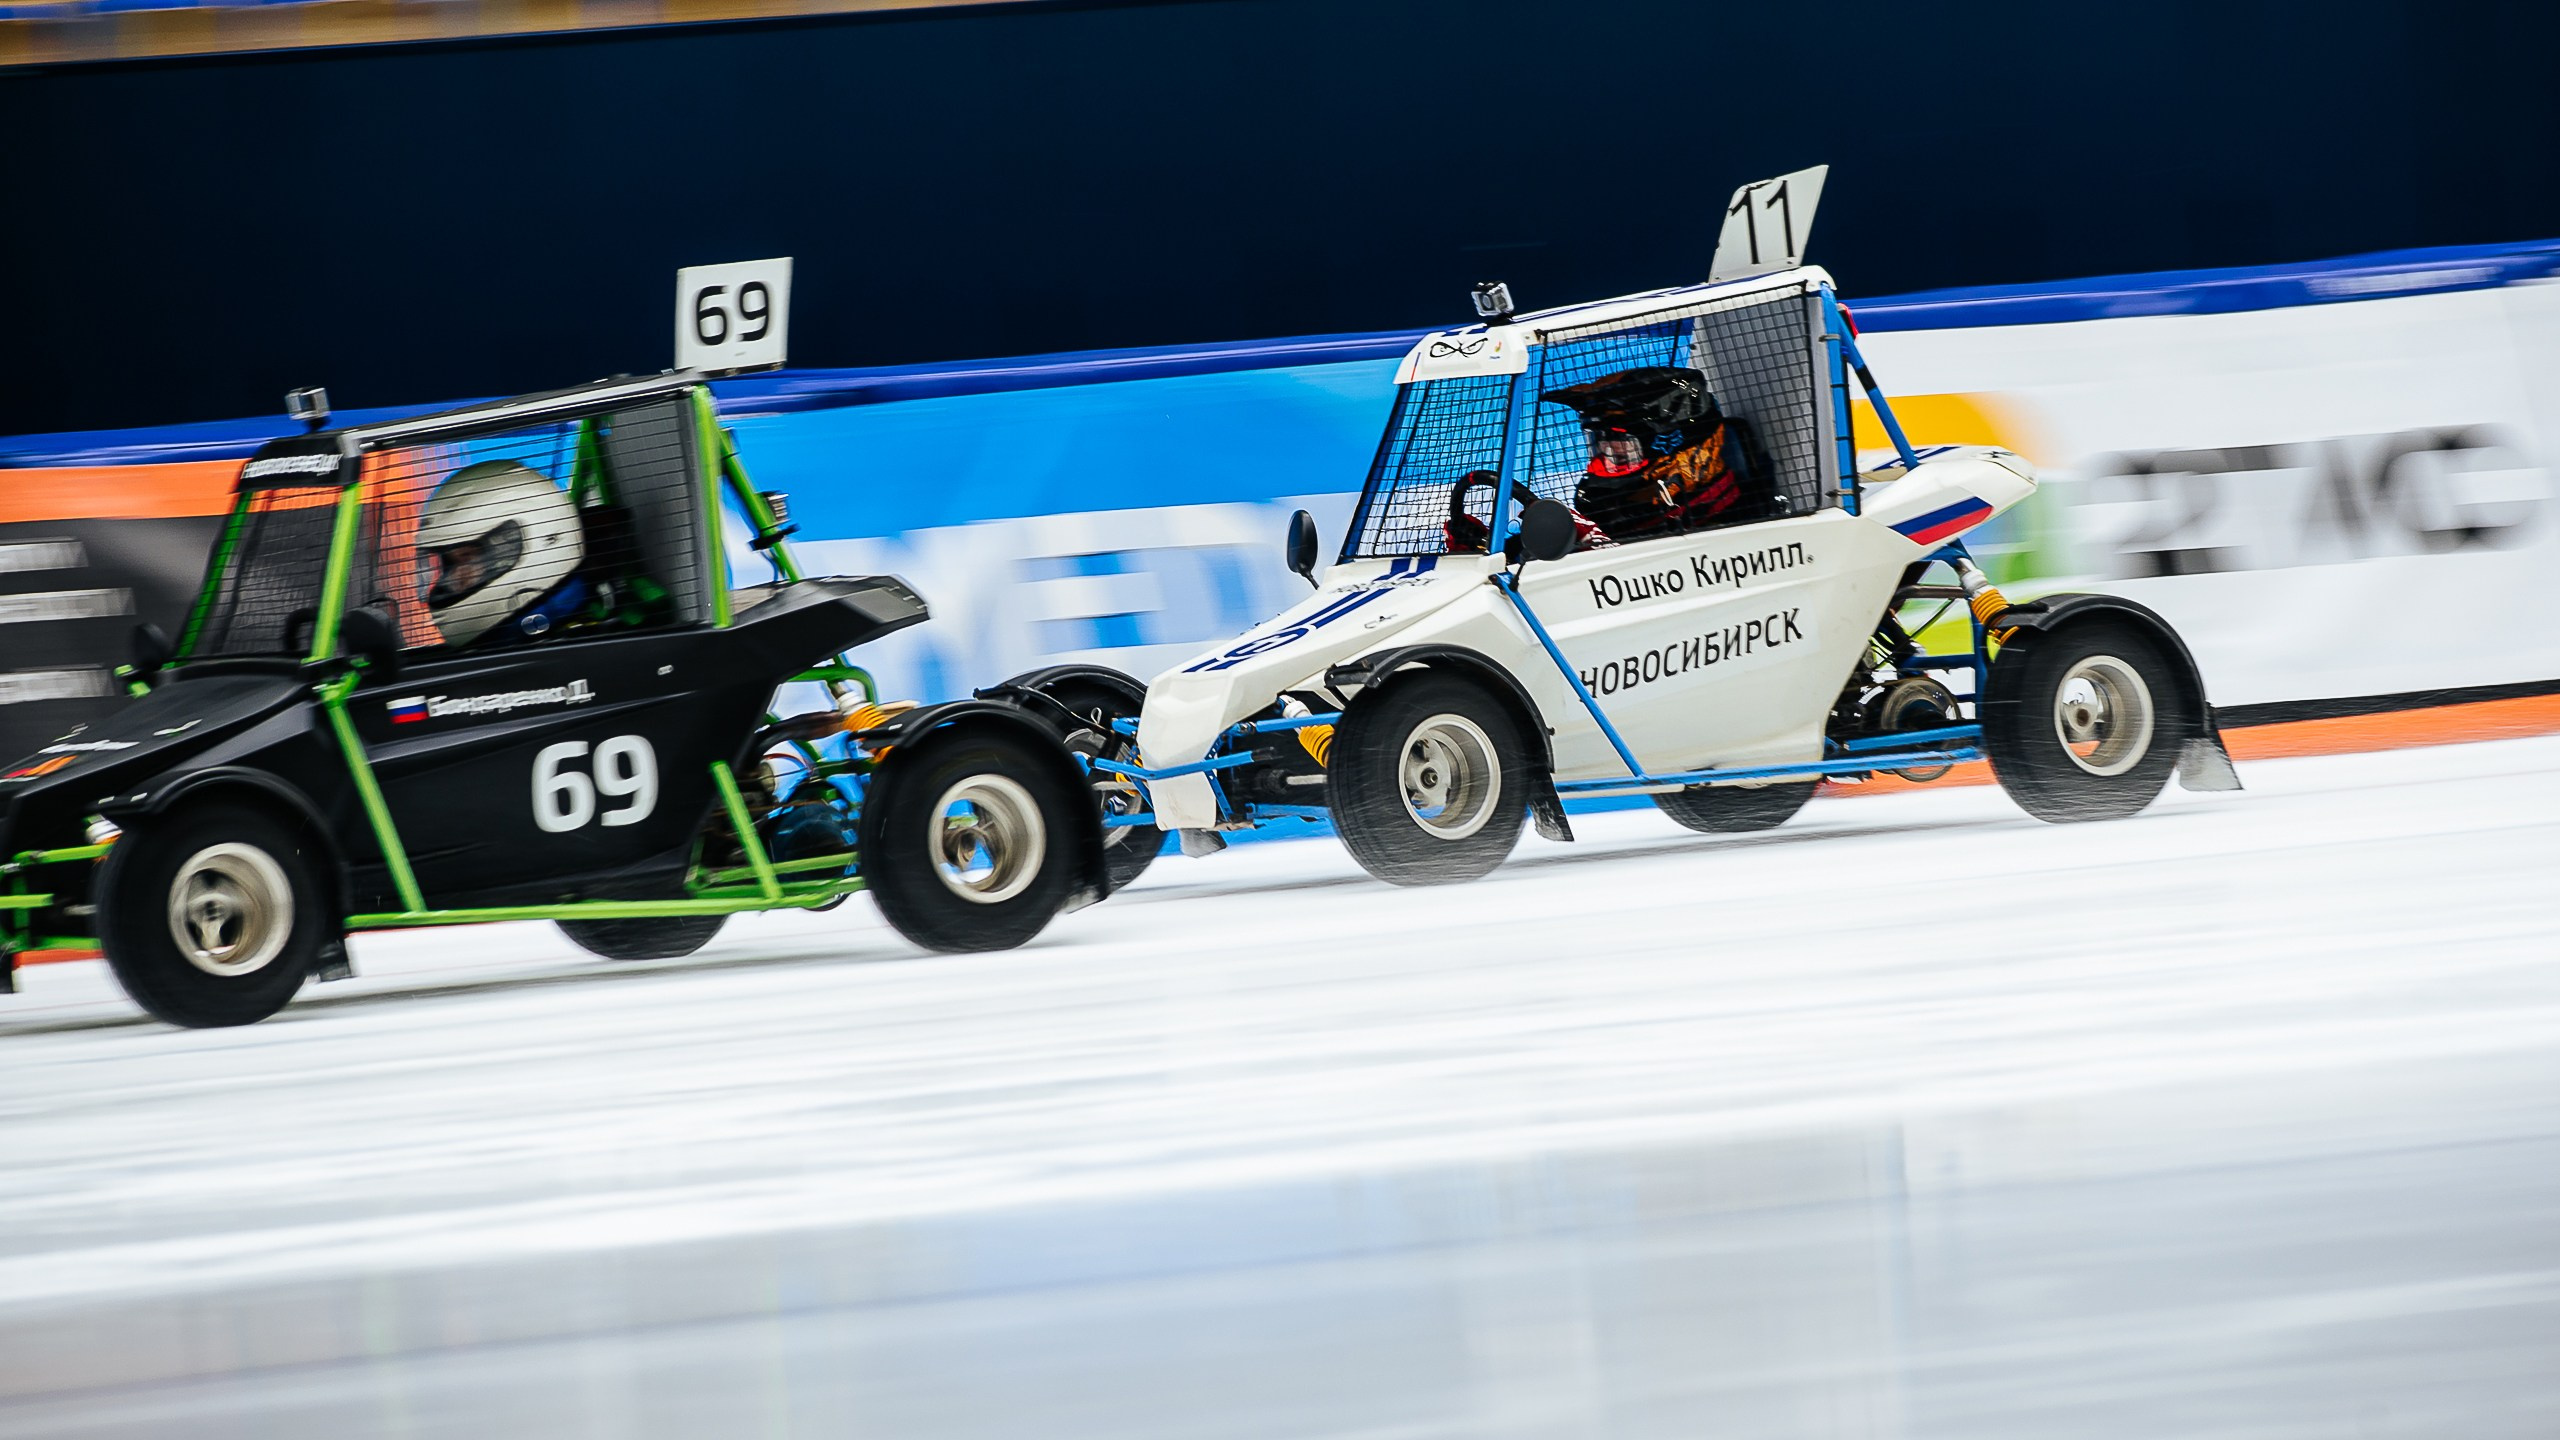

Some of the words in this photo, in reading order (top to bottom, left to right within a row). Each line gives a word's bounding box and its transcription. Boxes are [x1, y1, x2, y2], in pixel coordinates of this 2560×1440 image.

[1730, 180, 1794, 264] 11
[692, 281, 771, 346] 69
[1588, 569, 1684, 609] Юшко
[1580, 608, 1804, 702] НОВОСИБИРСК
[531, 734, 659, 833] 69
